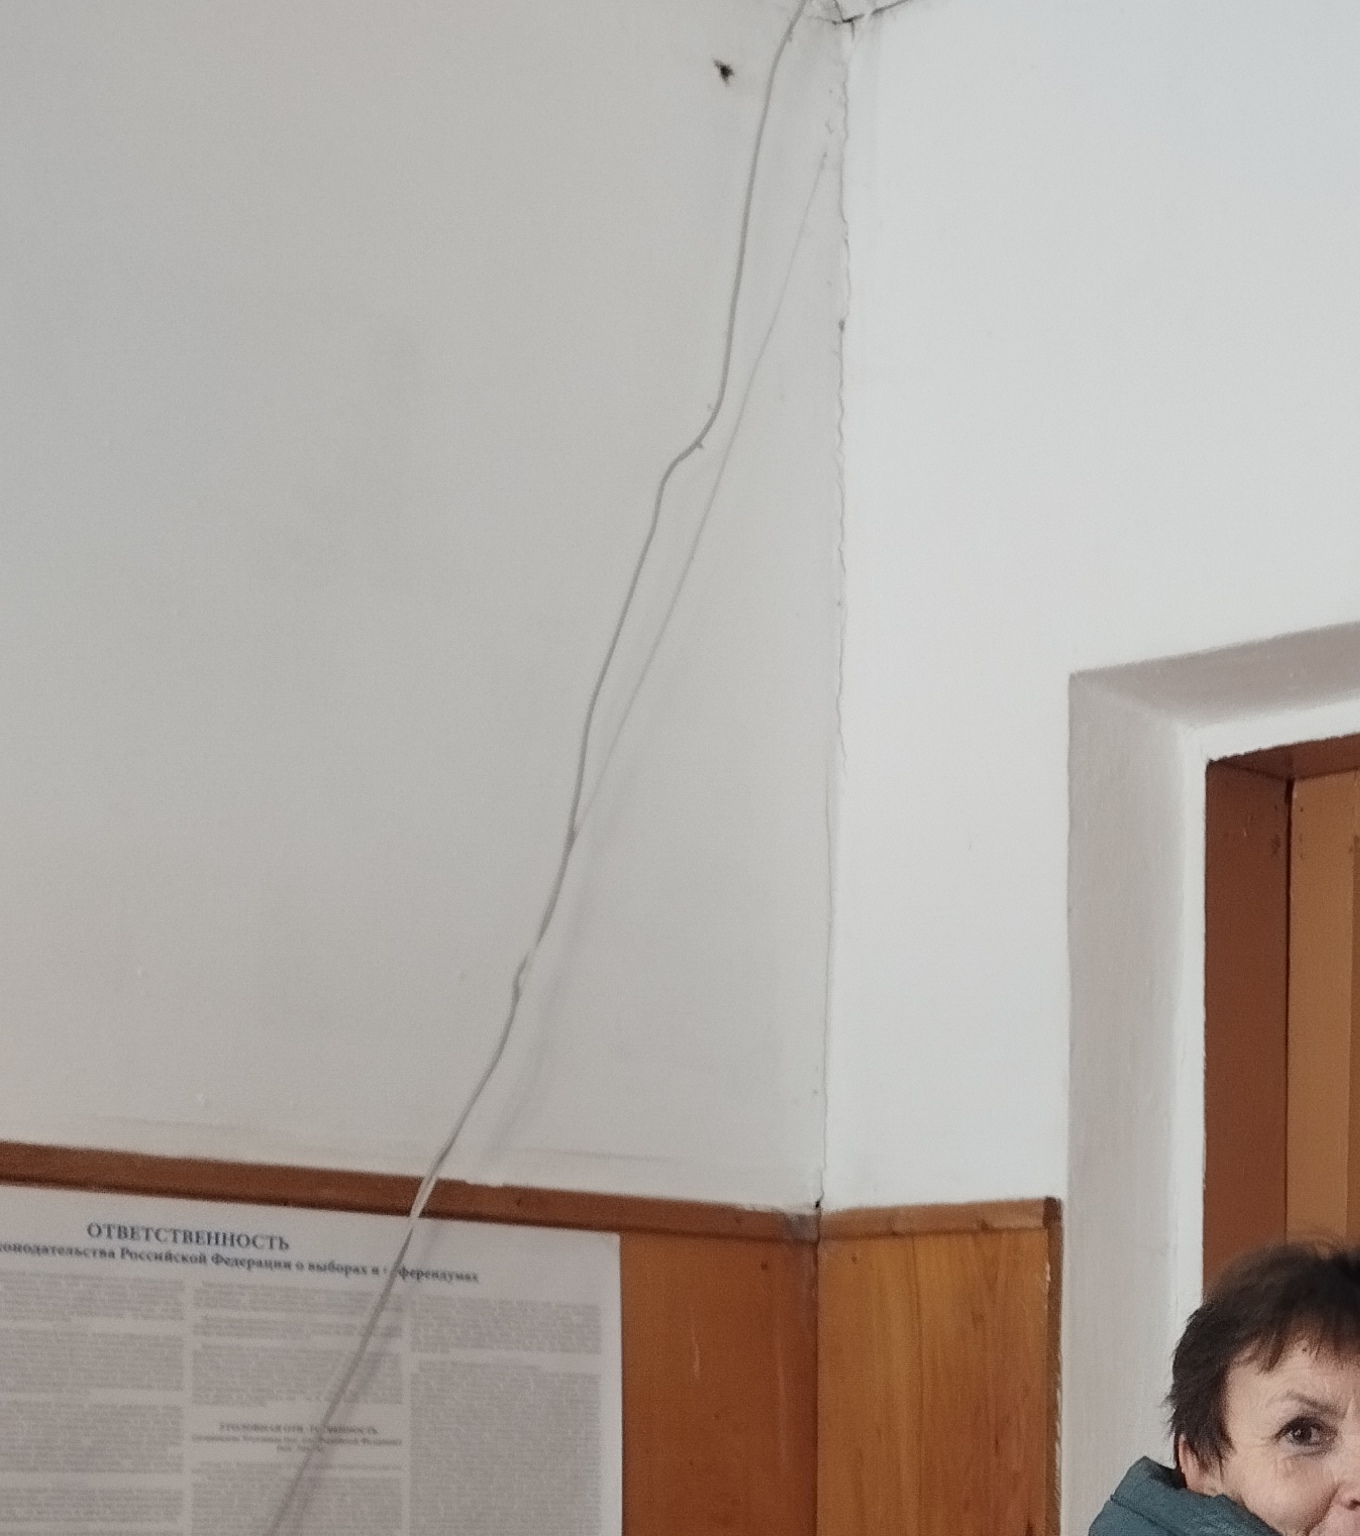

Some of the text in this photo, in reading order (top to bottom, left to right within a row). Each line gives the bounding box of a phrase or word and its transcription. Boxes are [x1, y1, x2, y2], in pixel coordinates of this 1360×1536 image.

[87, 1222, 290, 1251] ОТВЕТСТВЕННОСТЬ
[0, 1243, 116, 1259] онодательства
[120, 1247, 208, 1265] Российской
[211, 1252, 292, 1271] Федерации
[383, 1265, 480, 1284] ферендумах
